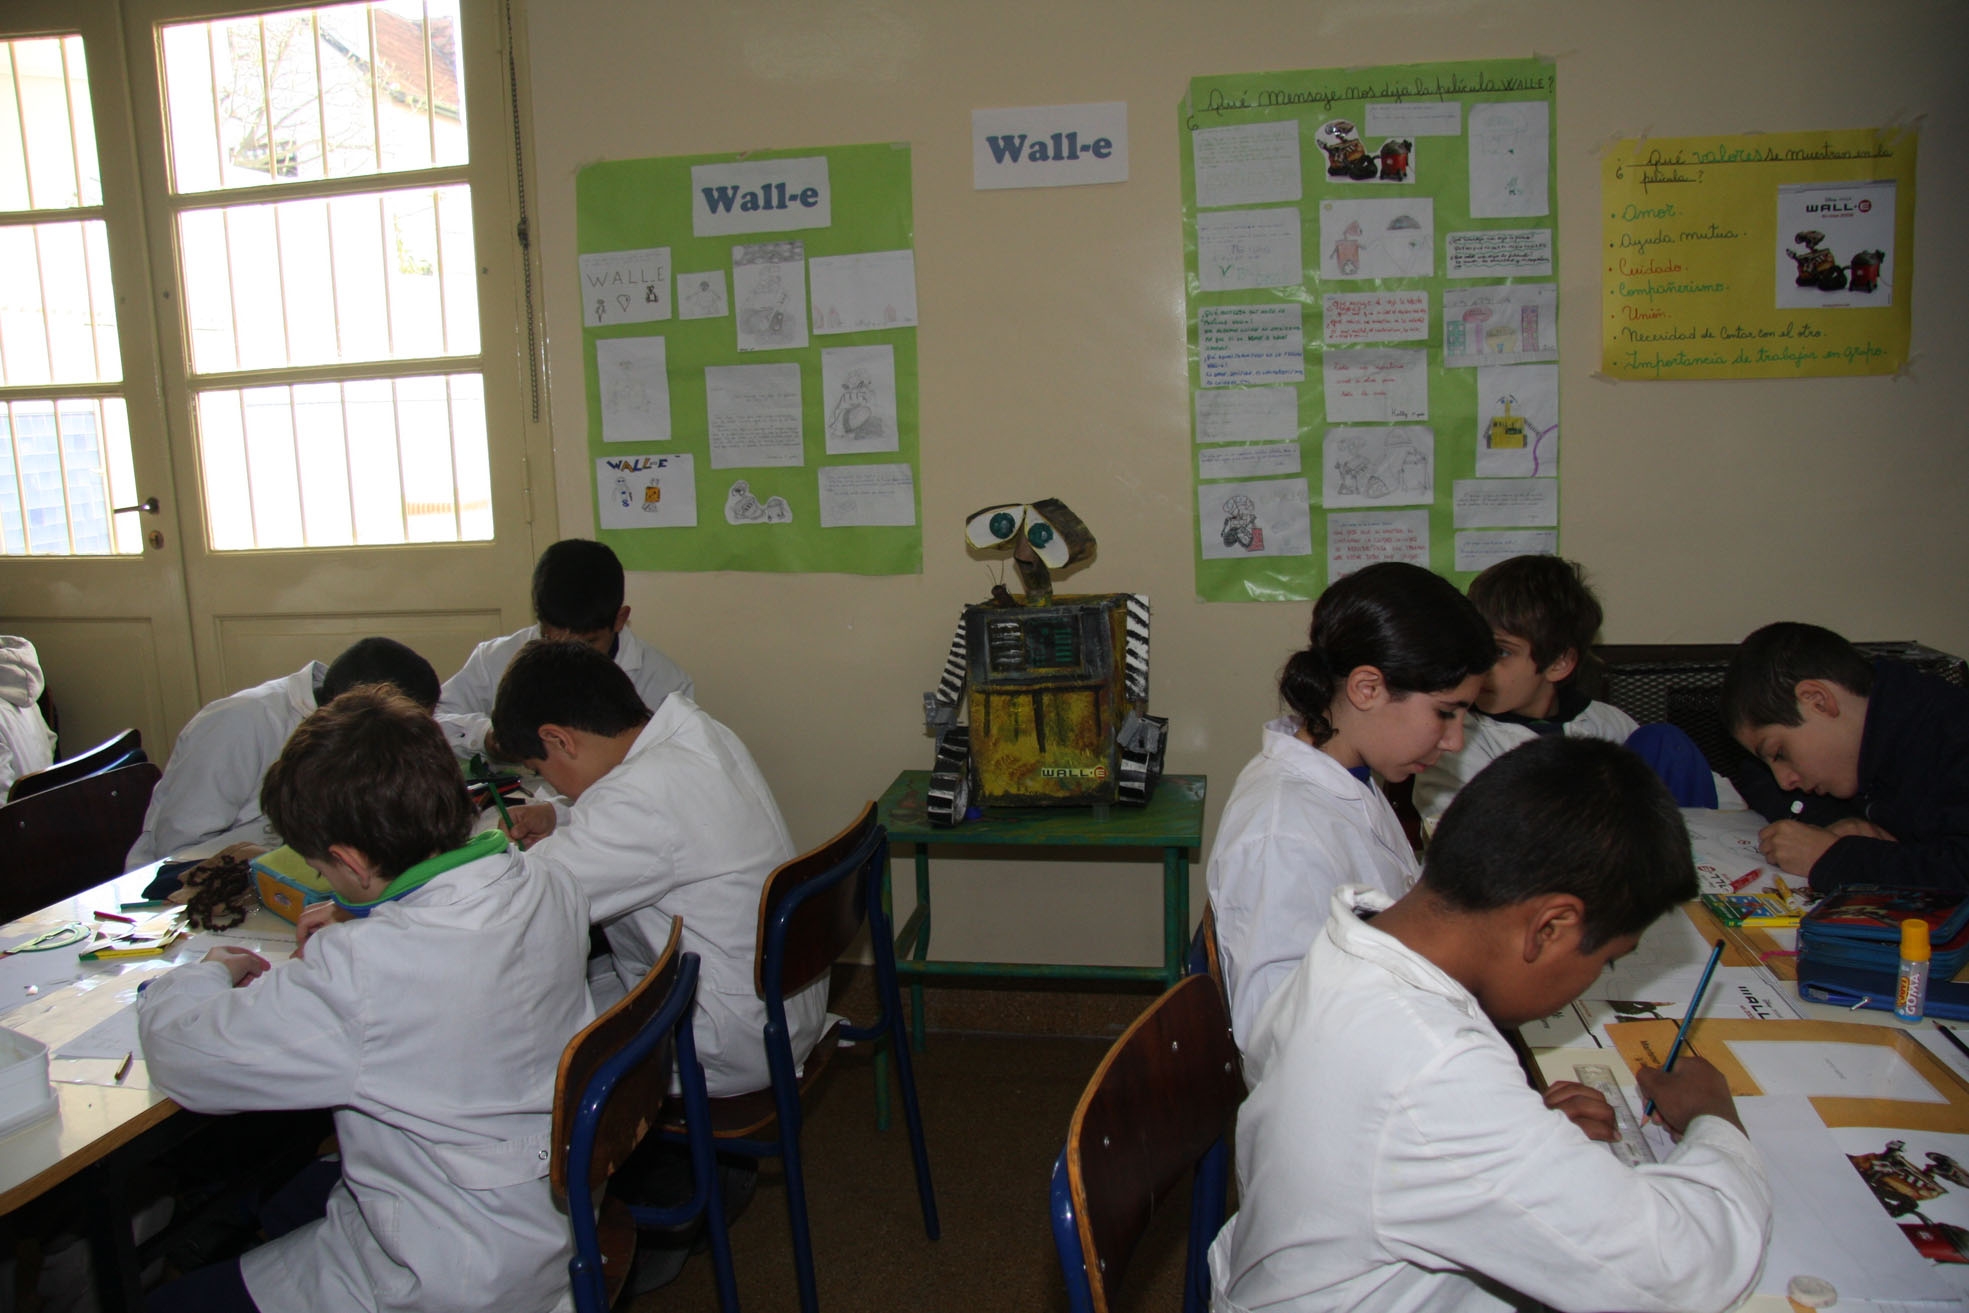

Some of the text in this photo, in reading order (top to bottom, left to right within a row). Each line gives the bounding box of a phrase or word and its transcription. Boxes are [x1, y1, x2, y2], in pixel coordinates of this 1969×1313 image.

[985, 131, 1113, 164] Wall-e
[702, 182, 820, 215] Wall-e
[1701, 328, 1715, 339] de
[1731, 347, 1753, 364] de
[1906, 973, 1921, 1015] GOMA
